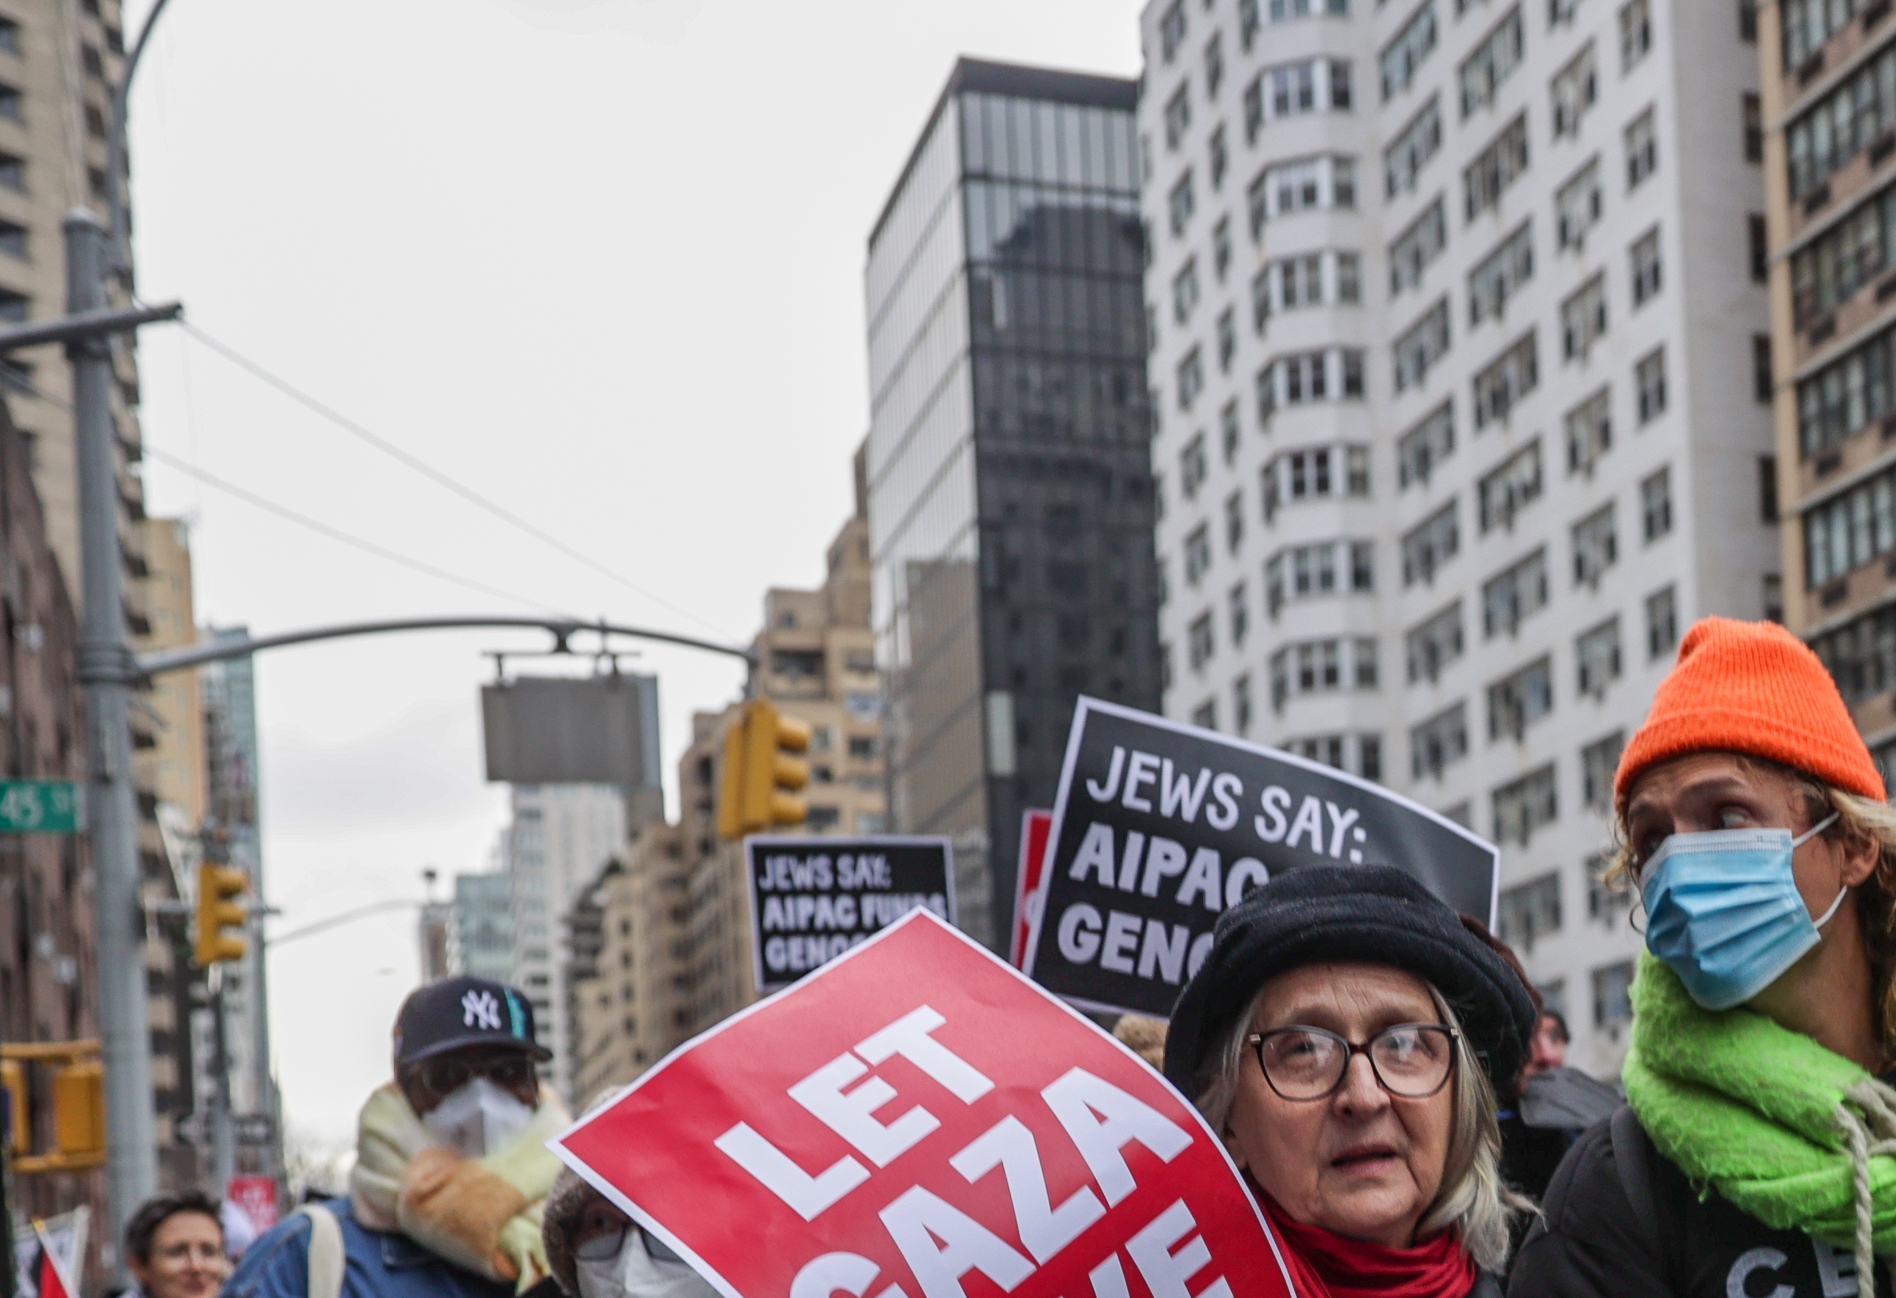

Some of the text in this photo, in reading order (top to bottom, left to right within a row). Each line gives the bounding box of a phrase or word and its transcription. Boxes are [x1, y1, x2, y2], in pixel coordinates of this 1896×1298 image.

[1086, 746, 1367, 863] JEWS SAY:
[758, 854, 834, 891] JEWS
[1068, 821, 1271, 911] AIPAC
[762, 894, 858, 931] AIPAC
[461, 989, 501, 1030] NY
[713, 1004, 997, 1223] LET
